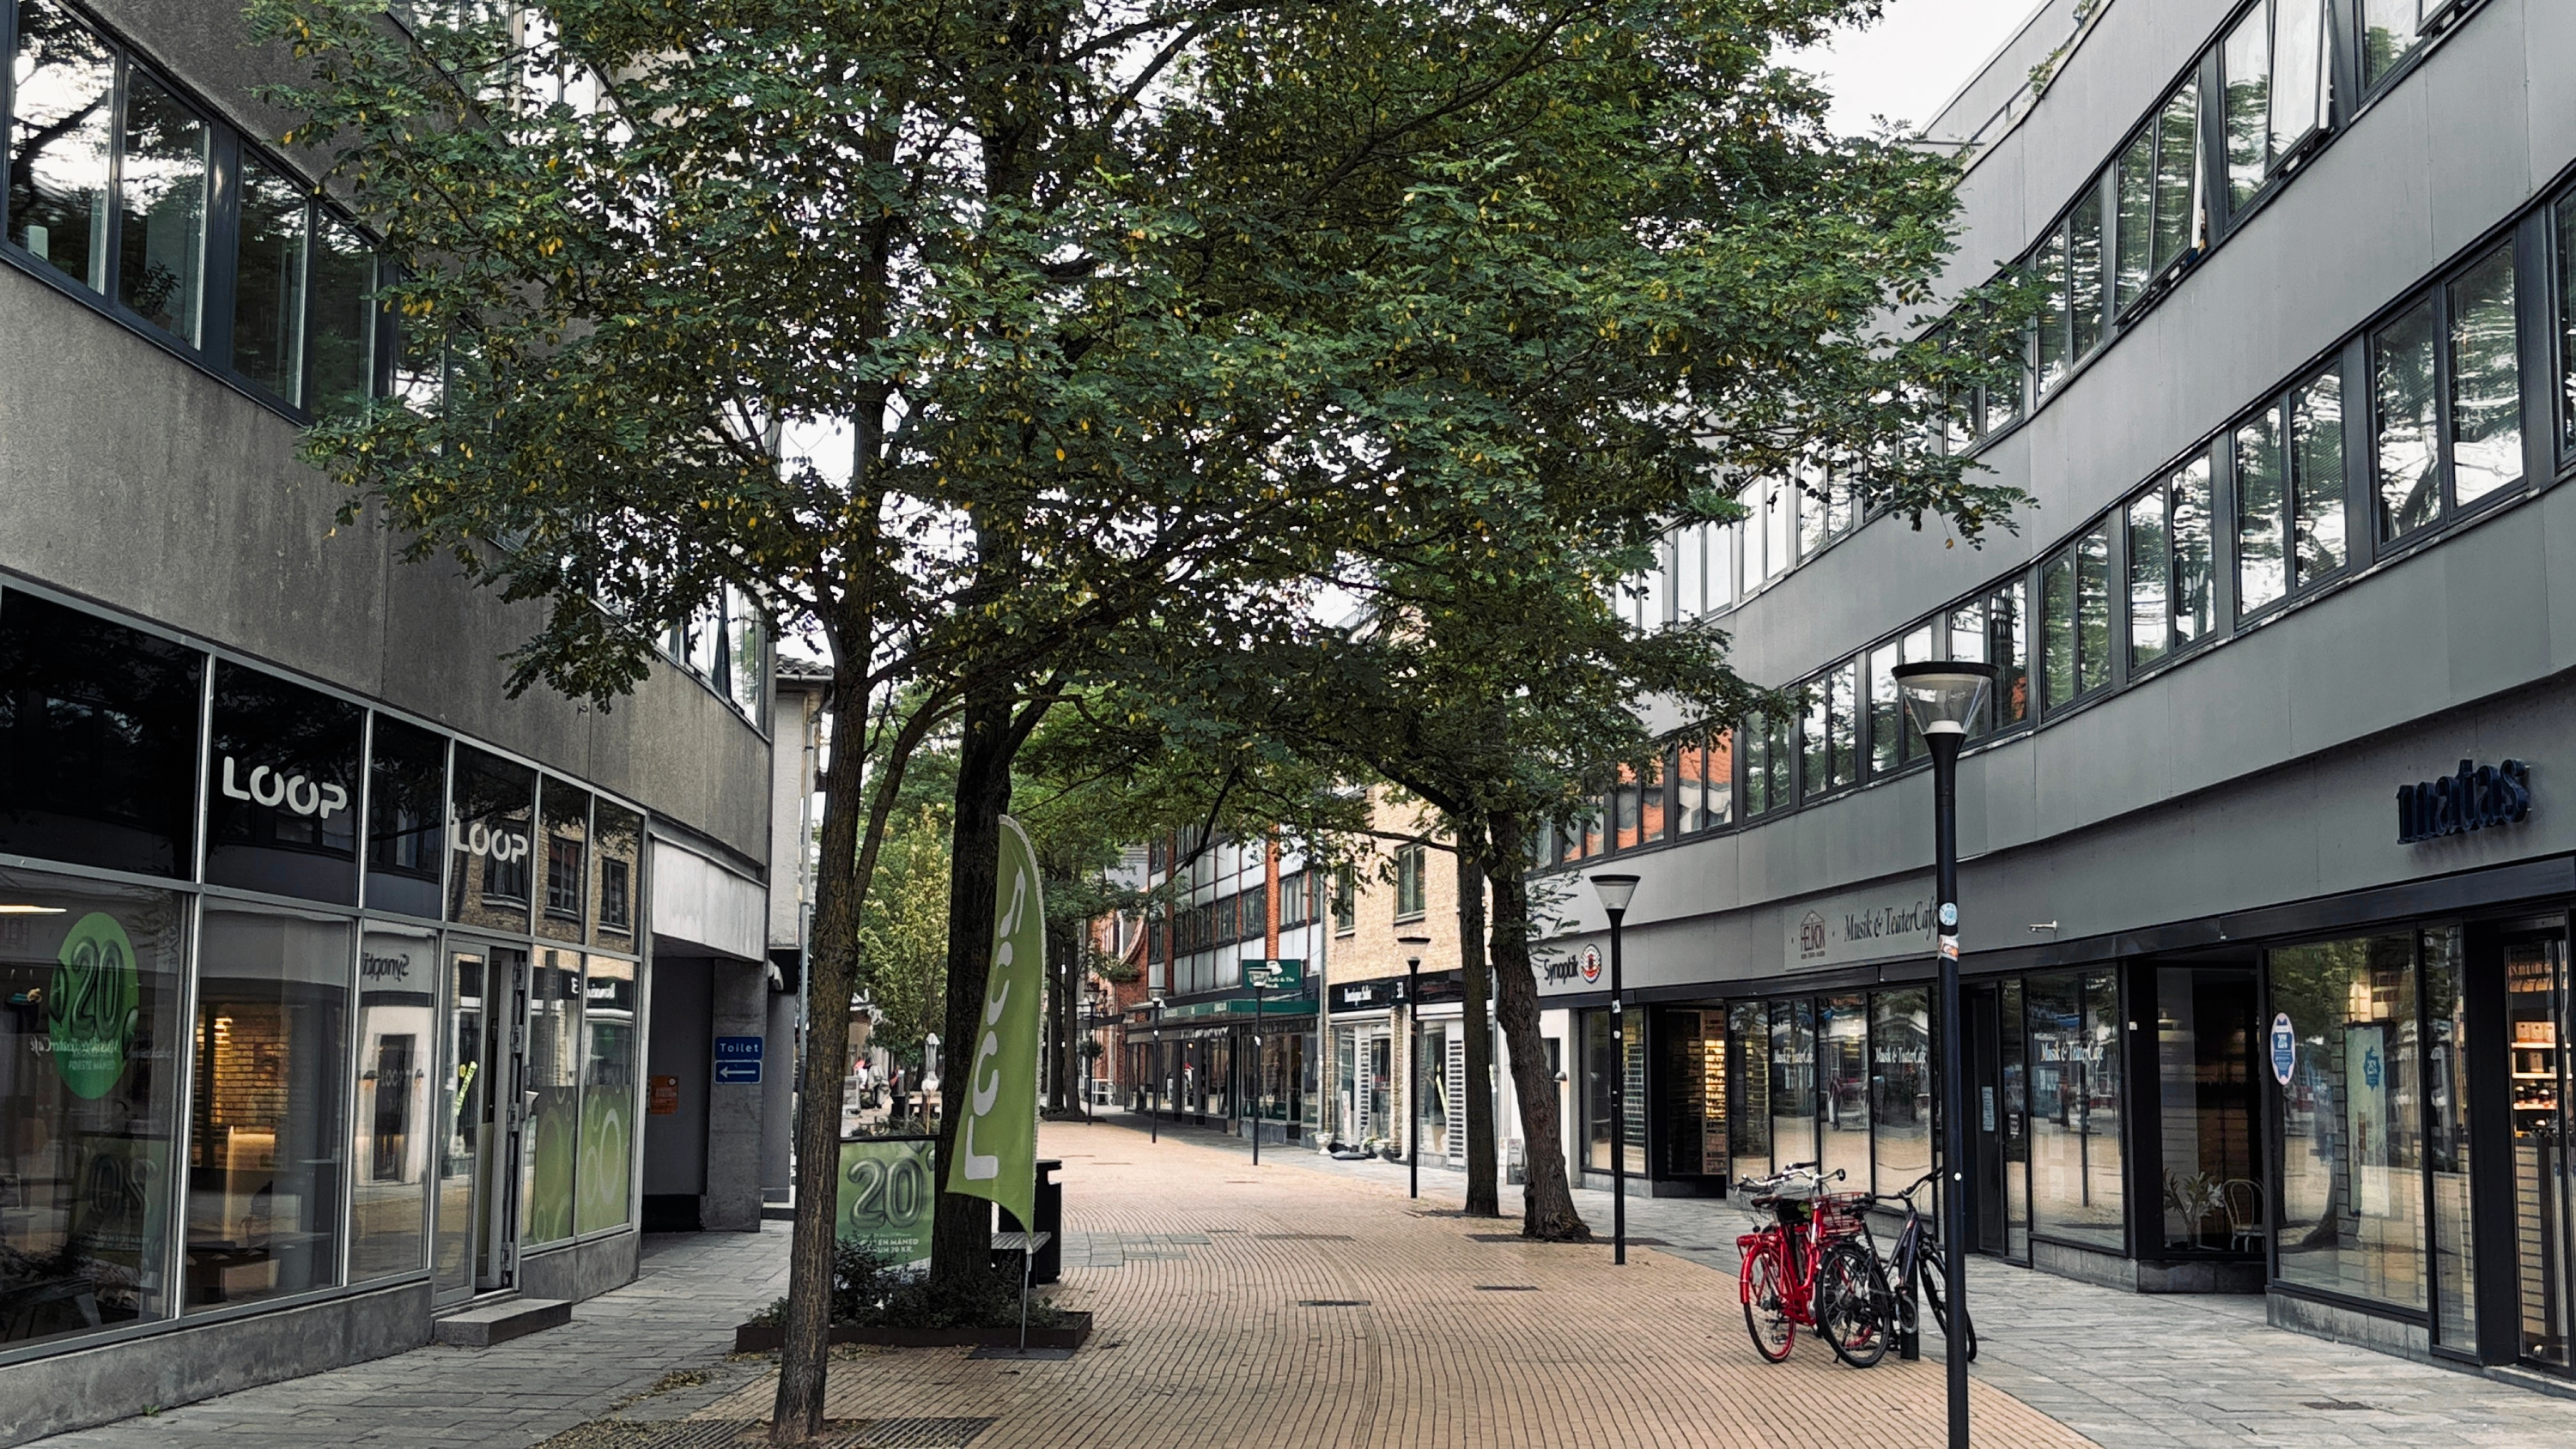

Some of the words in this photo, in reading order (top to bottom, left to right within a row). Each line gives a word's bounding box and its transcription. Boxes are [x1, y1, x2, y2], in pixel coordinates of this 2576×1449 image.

[223, 756, 347, 819] LOOP
[2395, 759, 2528, 845] matas
[453, 817, 529, 864] LOOP
[1844, 908, 1872, 943] Musik
[1874, 910, 1883, 938] &
[71, 936, 124, 1040] 20
[1544, 955, 1578, 985] Synoptik
[719, 1043, 759, 1053] Toilet
[847, 1157, 924, 1229] 20
[890, 1237, 920, 1246] MÅNED
